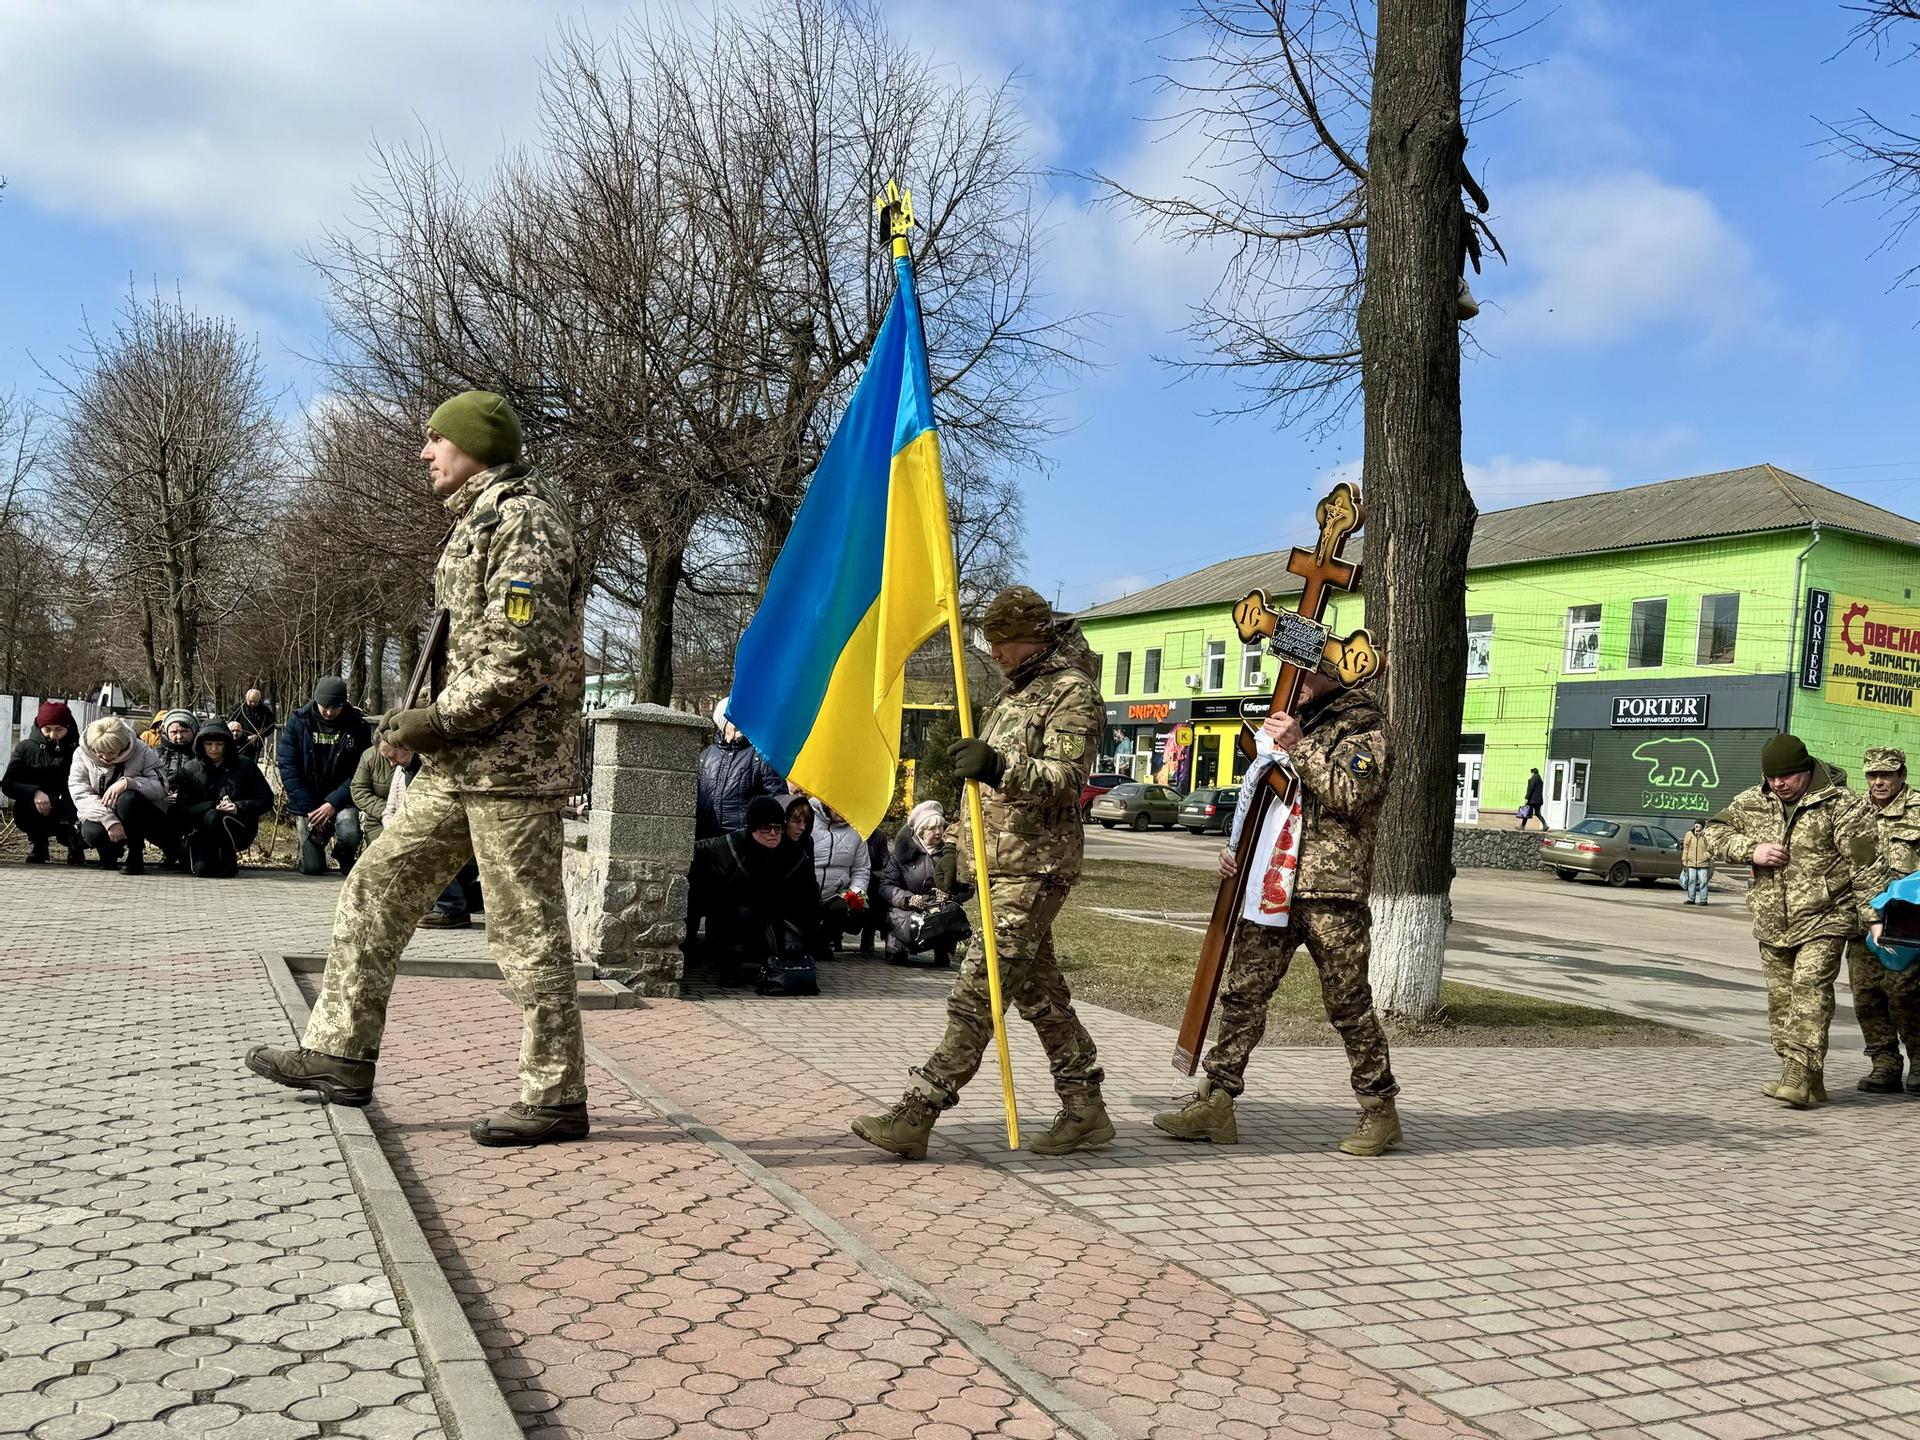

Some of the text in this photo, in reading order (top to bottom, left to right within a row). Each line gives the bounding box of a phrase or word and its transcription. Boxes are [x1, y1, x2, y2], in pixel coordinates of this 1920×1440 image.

[1808, 594, 1824, 684] PORTER
[1832, 663, 1844, 677] ДО
[1856, 682, 1913, 708] ТЕХНІКИ
[1128, 704, 1169, 722] DNIPRO
[1617, 698, 1698, 716] PORTER
[1641, 790, 1709, 812] PORTER
